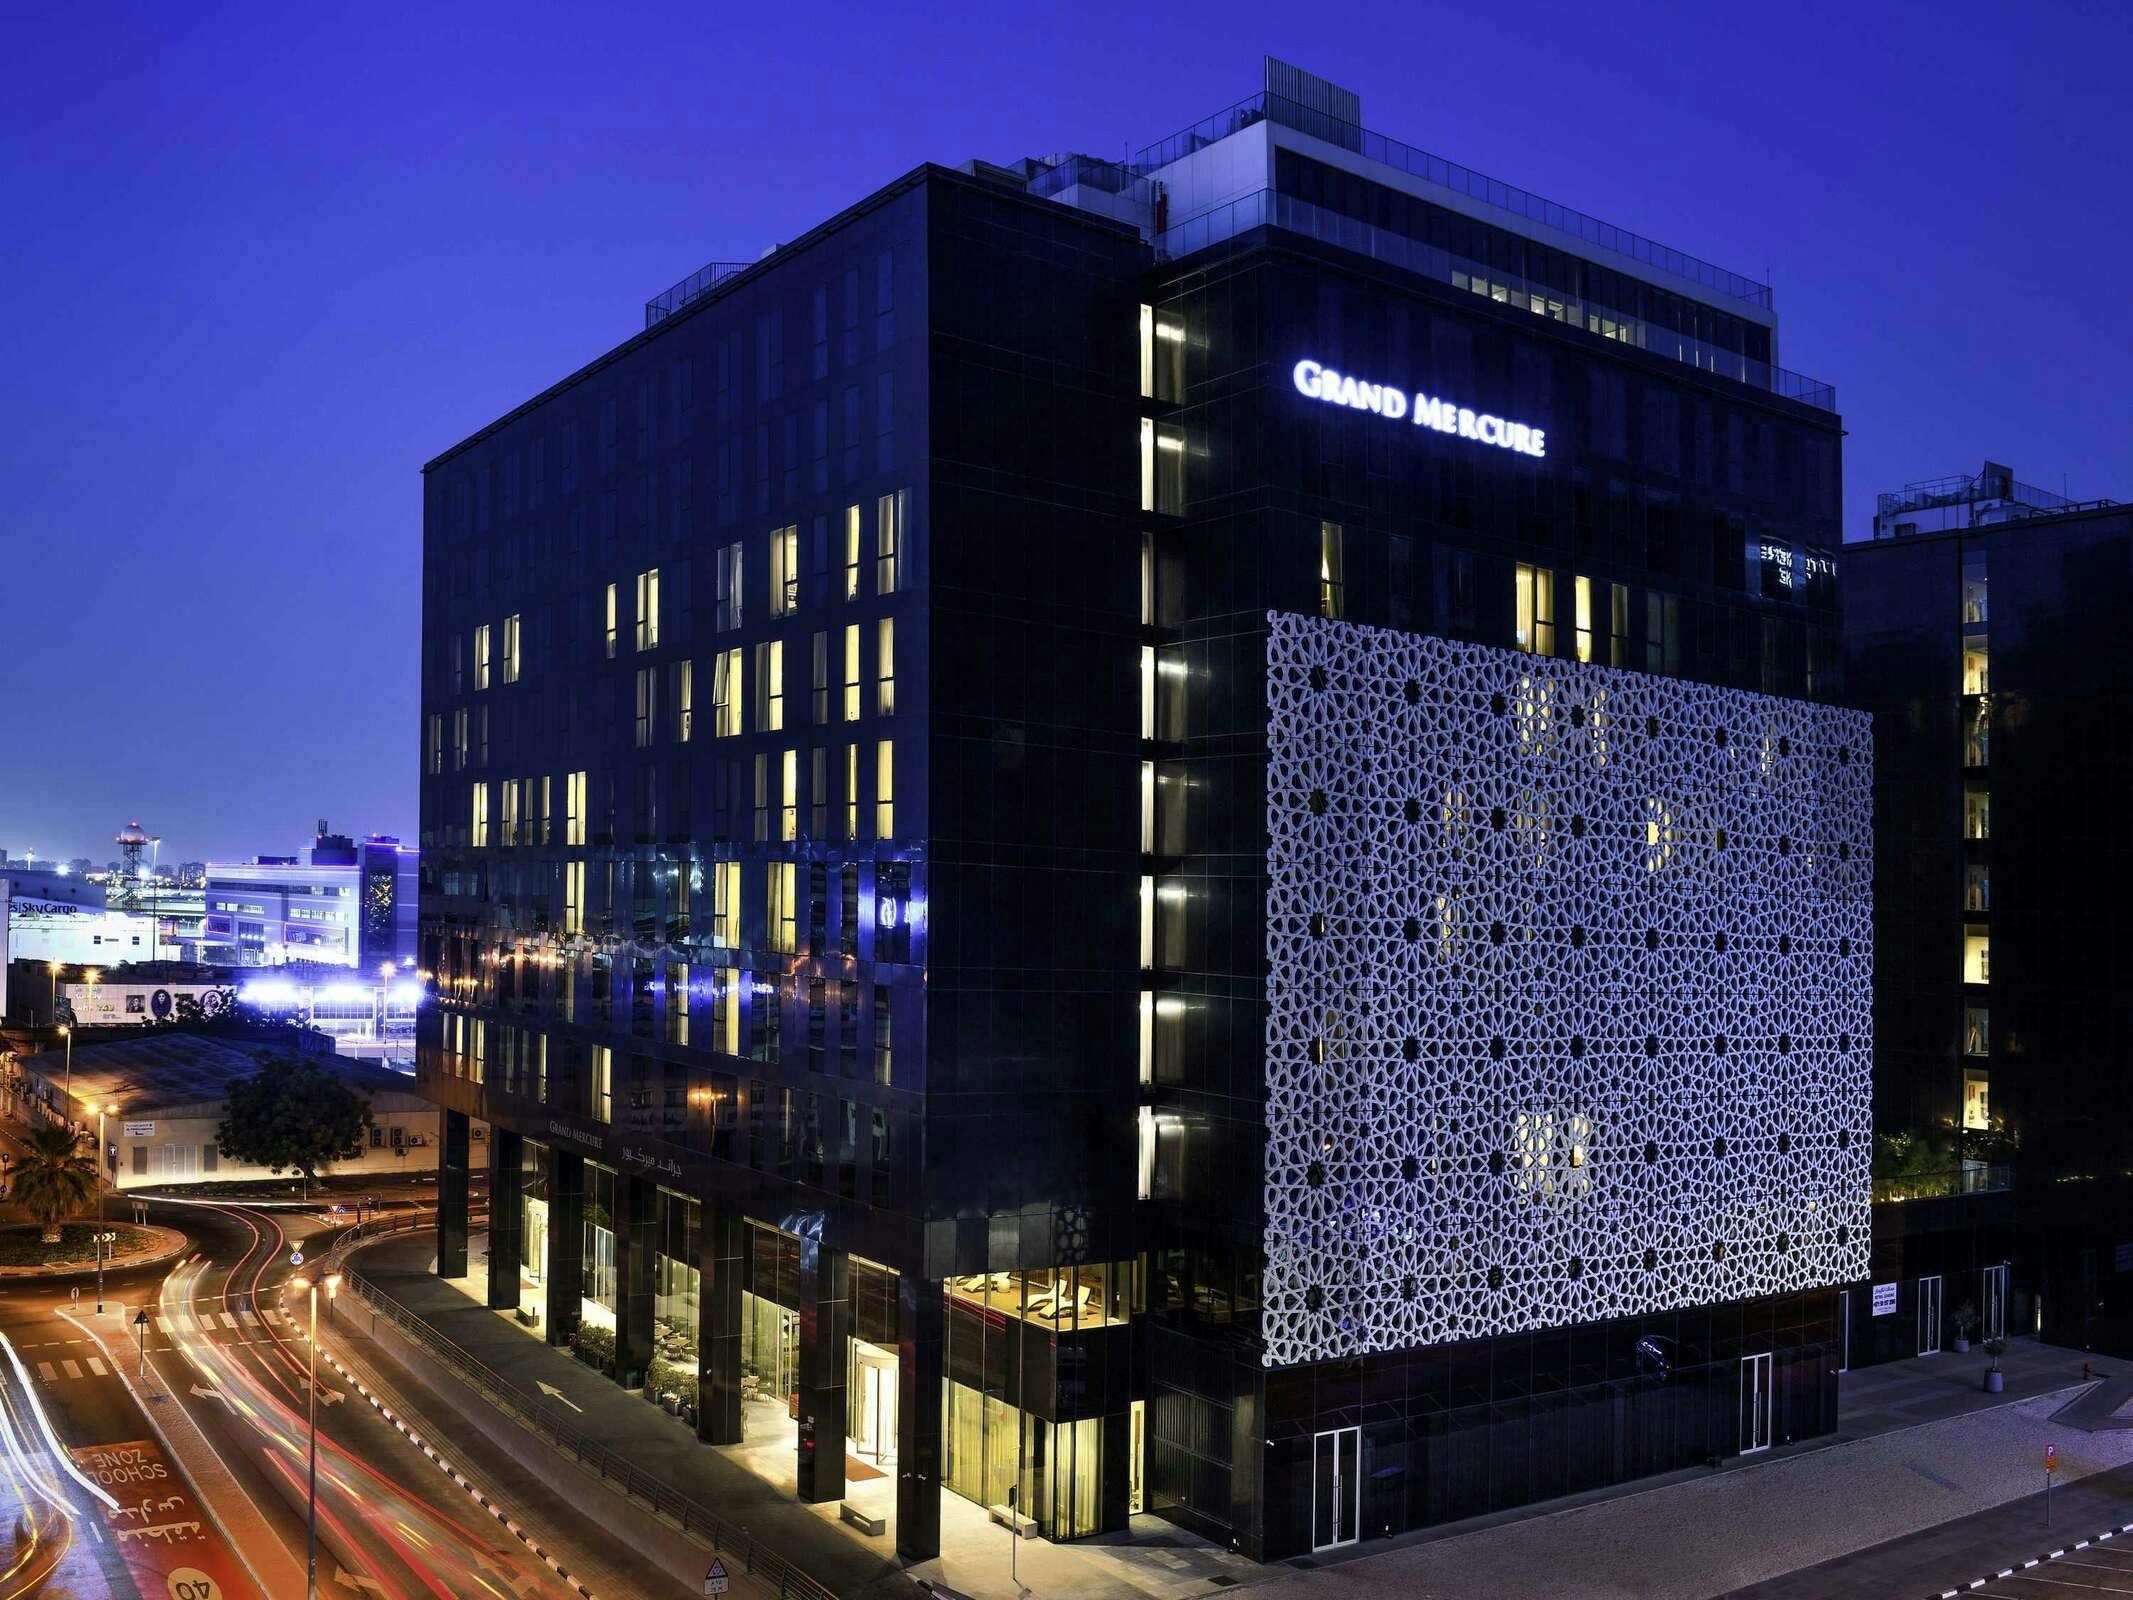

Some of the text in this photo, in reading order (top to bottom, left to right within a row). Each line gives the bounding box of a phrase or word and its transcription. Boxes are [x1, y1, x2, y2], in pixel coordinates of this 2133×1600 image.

[1294, 360, 1545, 457] GRAND MERCURE
[22, 902, 77, 915] SkyCargo
[549, 1120, 603, 1149] GRAND MERCURE
[93, 1449, 147, 1468] ZONE
[87, 1463, 168, 1485] SCHOOL
[117, 1522, 205, 1547] منطقة
[176, 1580, 210, 1600] 40
